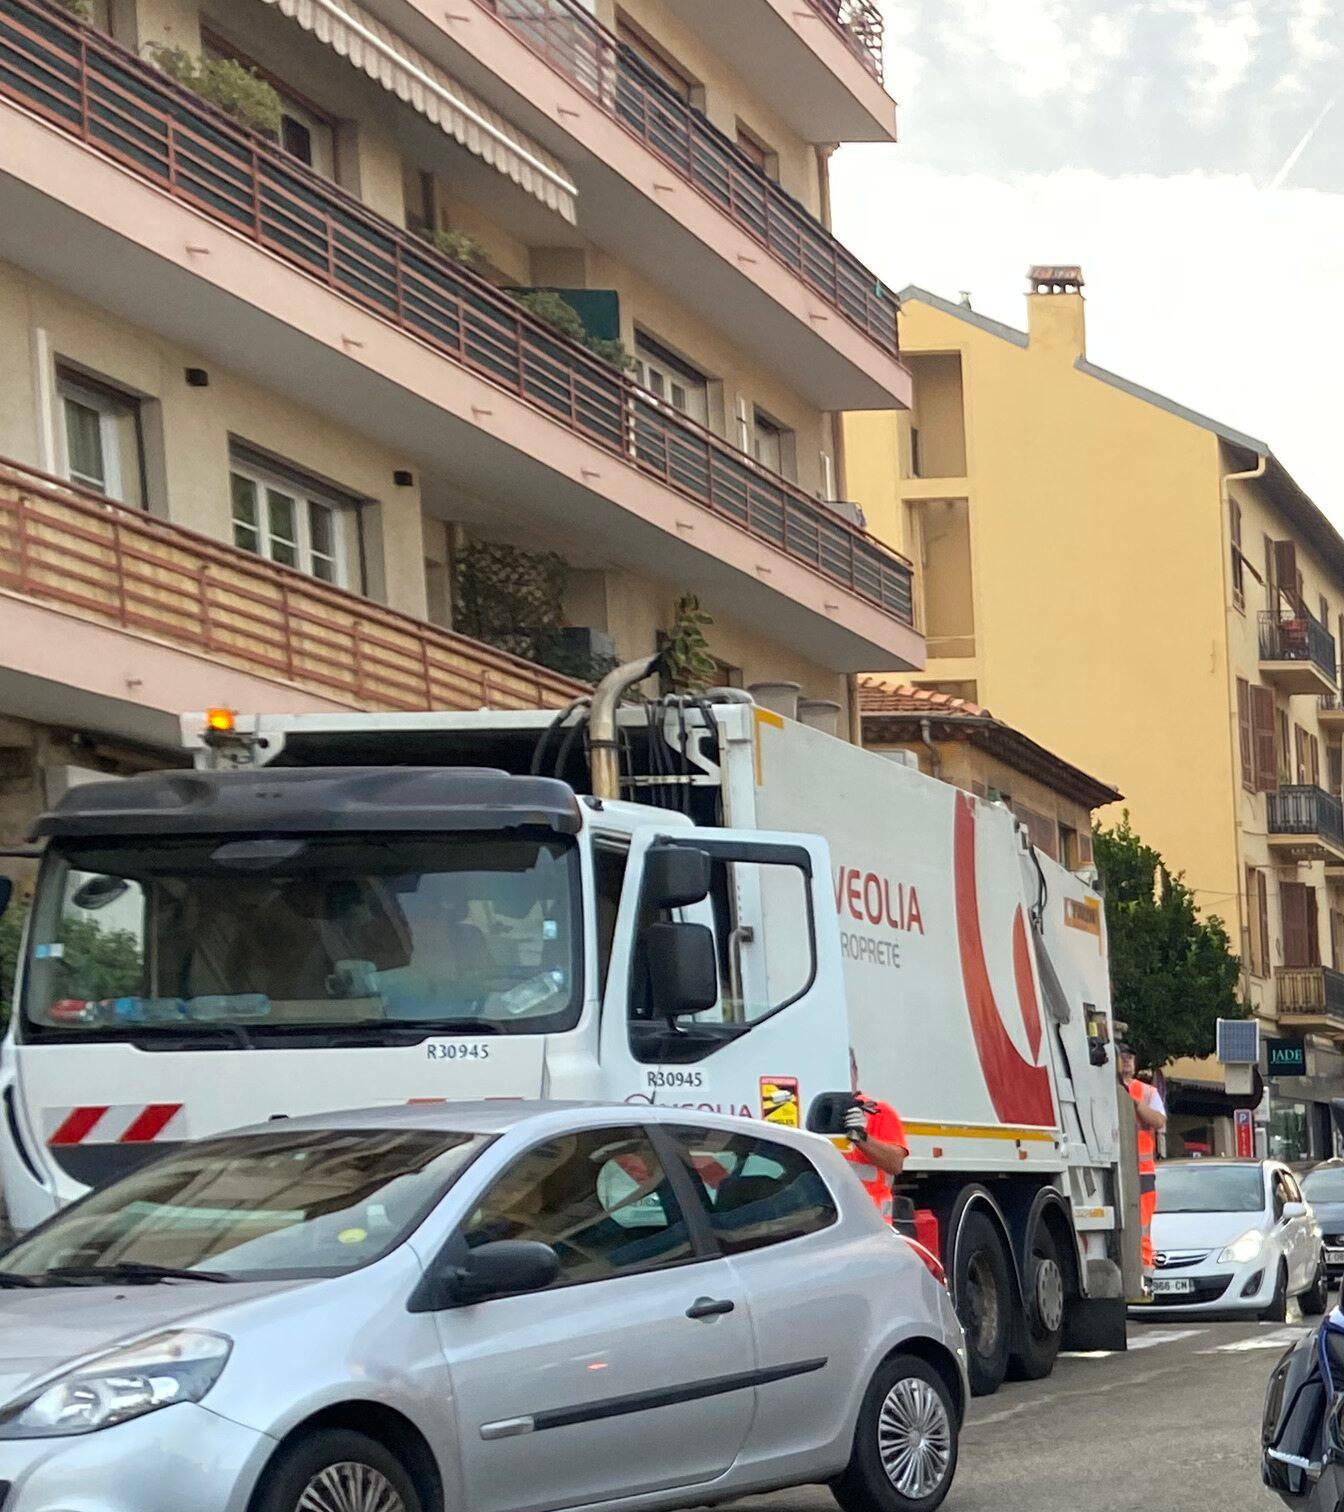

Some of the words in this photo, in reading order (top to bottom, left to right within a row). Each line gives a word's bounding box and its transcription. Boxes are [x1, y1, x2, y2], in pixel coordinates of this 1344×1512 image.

[426, 1044, 490, 1060] R30945
[1272, 1049, 1302, 1063] JADE
[647, 1071, 702, 1088] R30945
